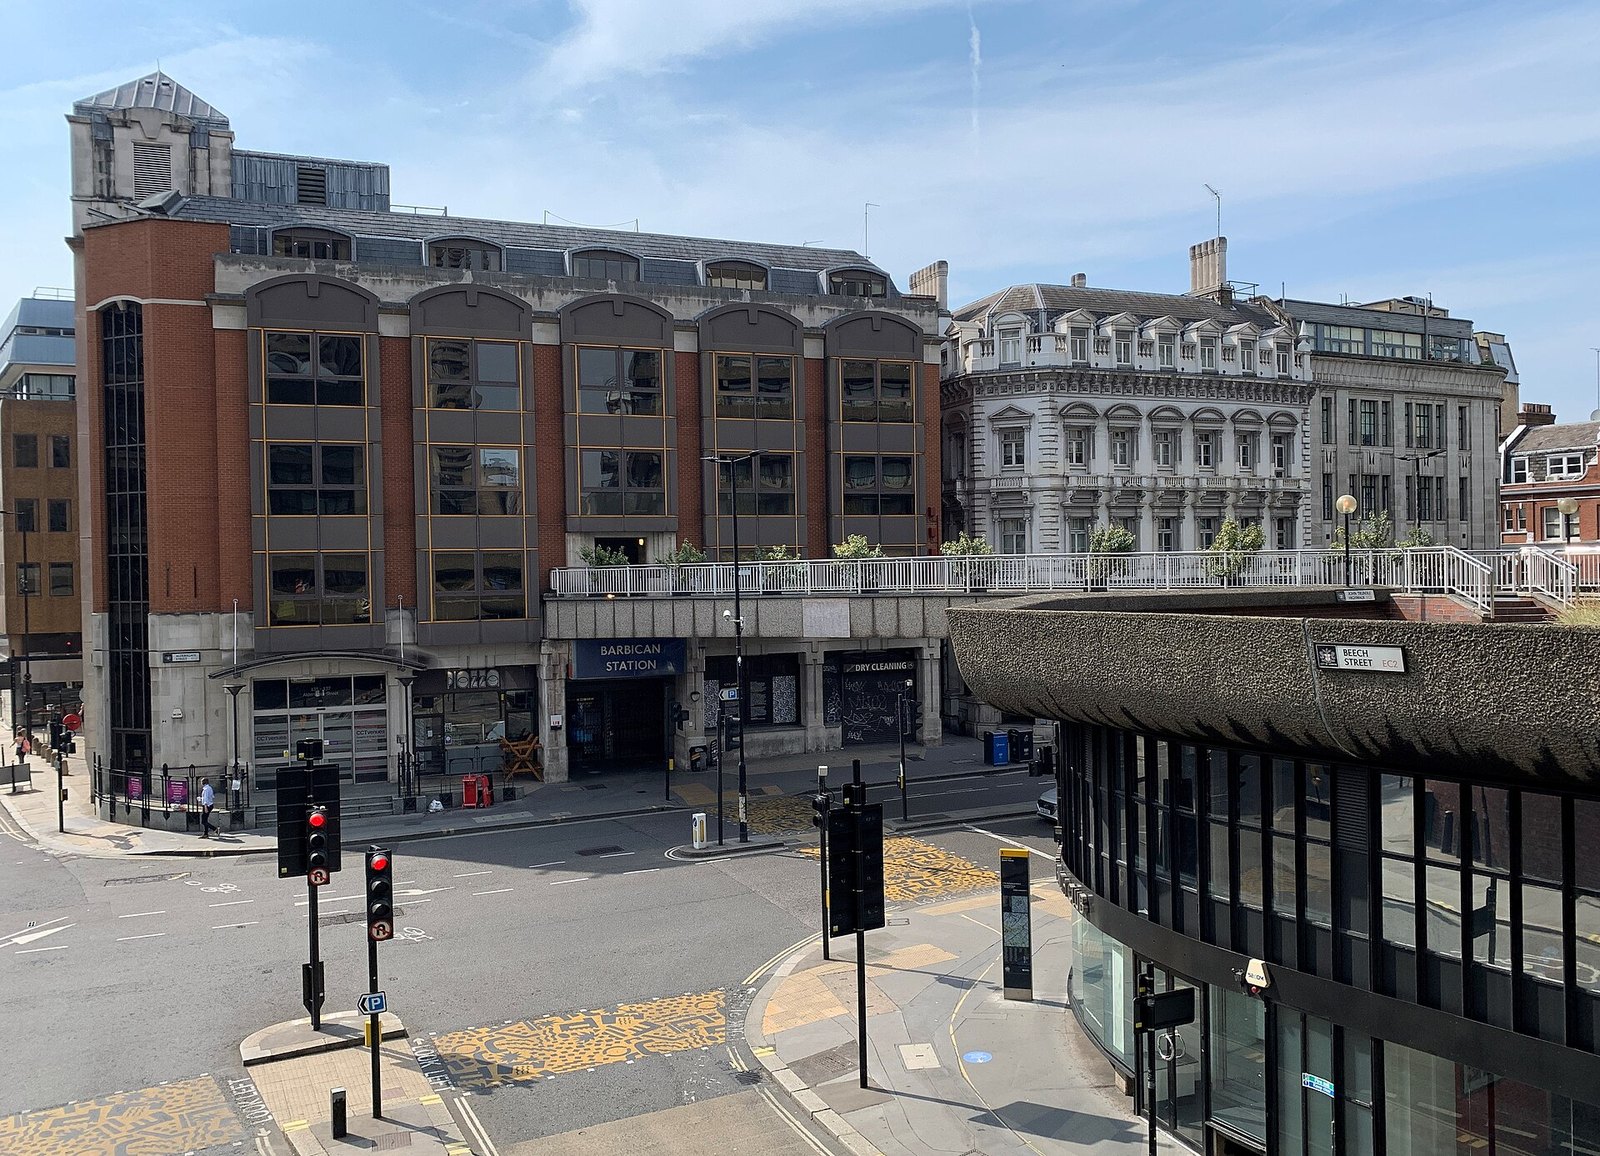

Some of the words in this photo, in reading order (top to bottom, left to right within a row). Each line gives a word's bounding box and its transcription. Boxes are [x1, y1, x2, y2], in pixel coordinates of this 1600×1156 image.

[600, 643, 661, 656] BARBICAN
[1343, 648, 1369, 657] BEECH
[606, 660, 657, 672] STATION
[855, 663, 870, 672] DRY
[871, 661, 907, 671] CLEANING
[1344, 658, 1373, 667] STREET
[1382, 660, 1398, 668] EC2
[412, 1044, 442, 1069] LOOK
[424, 1070, 456, 1092] LEFT
[227, 1077, 258, 1101] LEFT
[238, 1097, 274, 1125] LOOK
